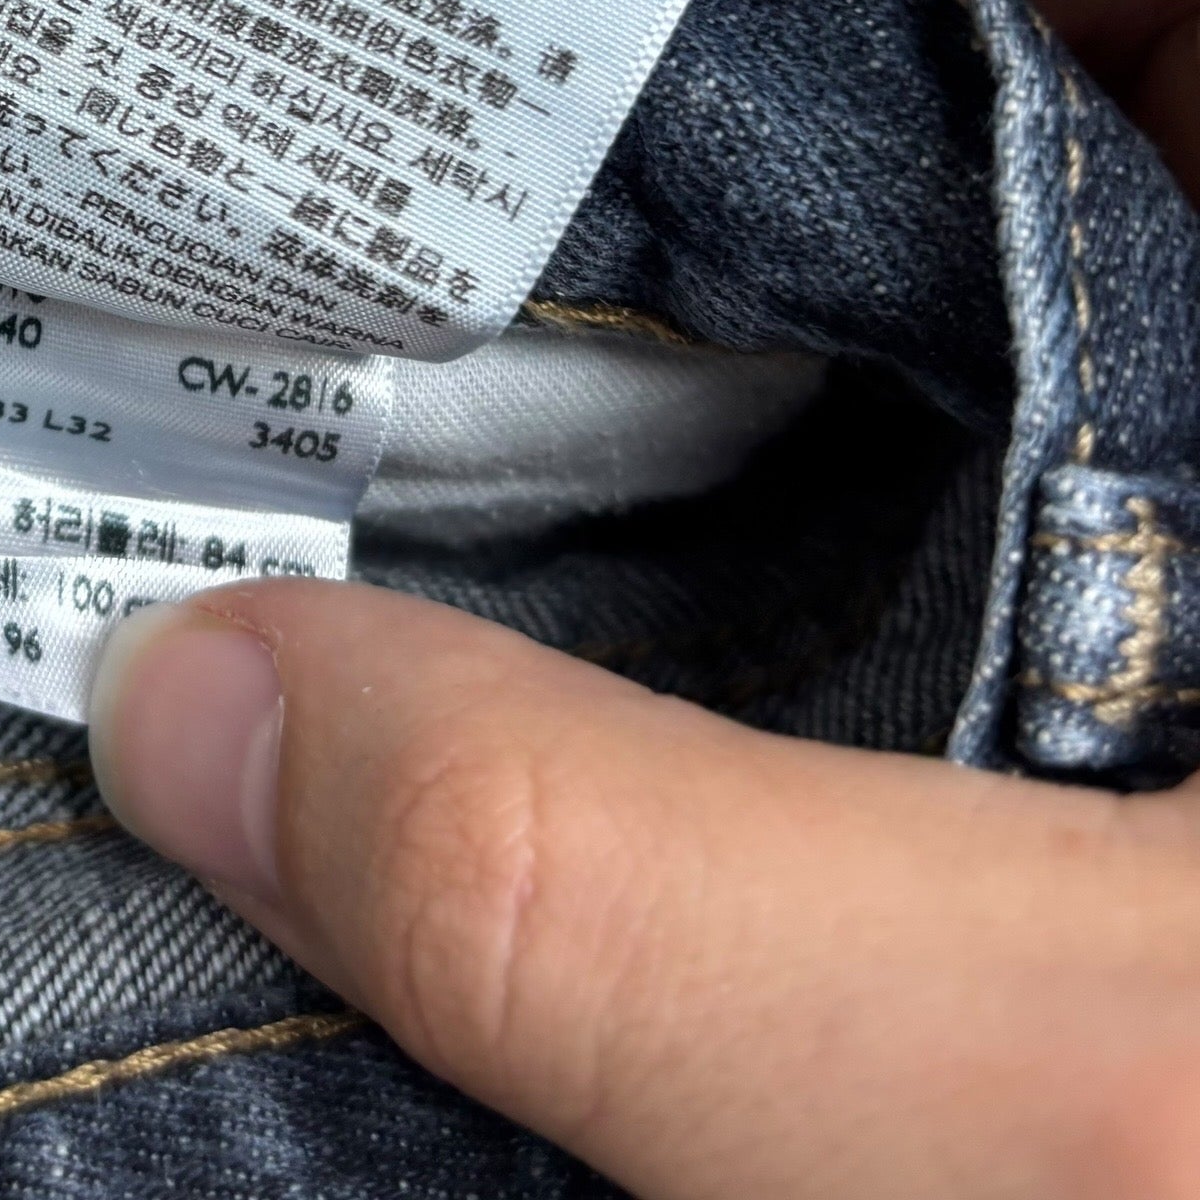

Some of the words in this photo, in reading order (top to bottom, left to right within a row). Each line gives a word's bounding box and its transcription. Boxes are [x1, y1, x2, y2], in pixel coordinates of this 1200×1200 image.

[103, 0, 246, 88] 색상끼리
[408, 146, 528, 222] 세탁시
[135, 62, 215, 119] 중성
[221, 103, 297, 161] 액체
[24, 204, 142, 270] DIBALIK
[149, 257, 286, 318] DENGAN
[292, 310, 405, 351] WARNA
[79, 189, 264, 285] PENCUCIAN
[266, 275, 340, 313] DAN
[77, 260, 189, 310] SABUN
[191, 303, 271, 335] CUCI
[43, 408, 112, 443] L32
[249, 421, 342, 462] 3405
[201, 534, 247, 570] 84
[57, 568, 115, 617] 100
